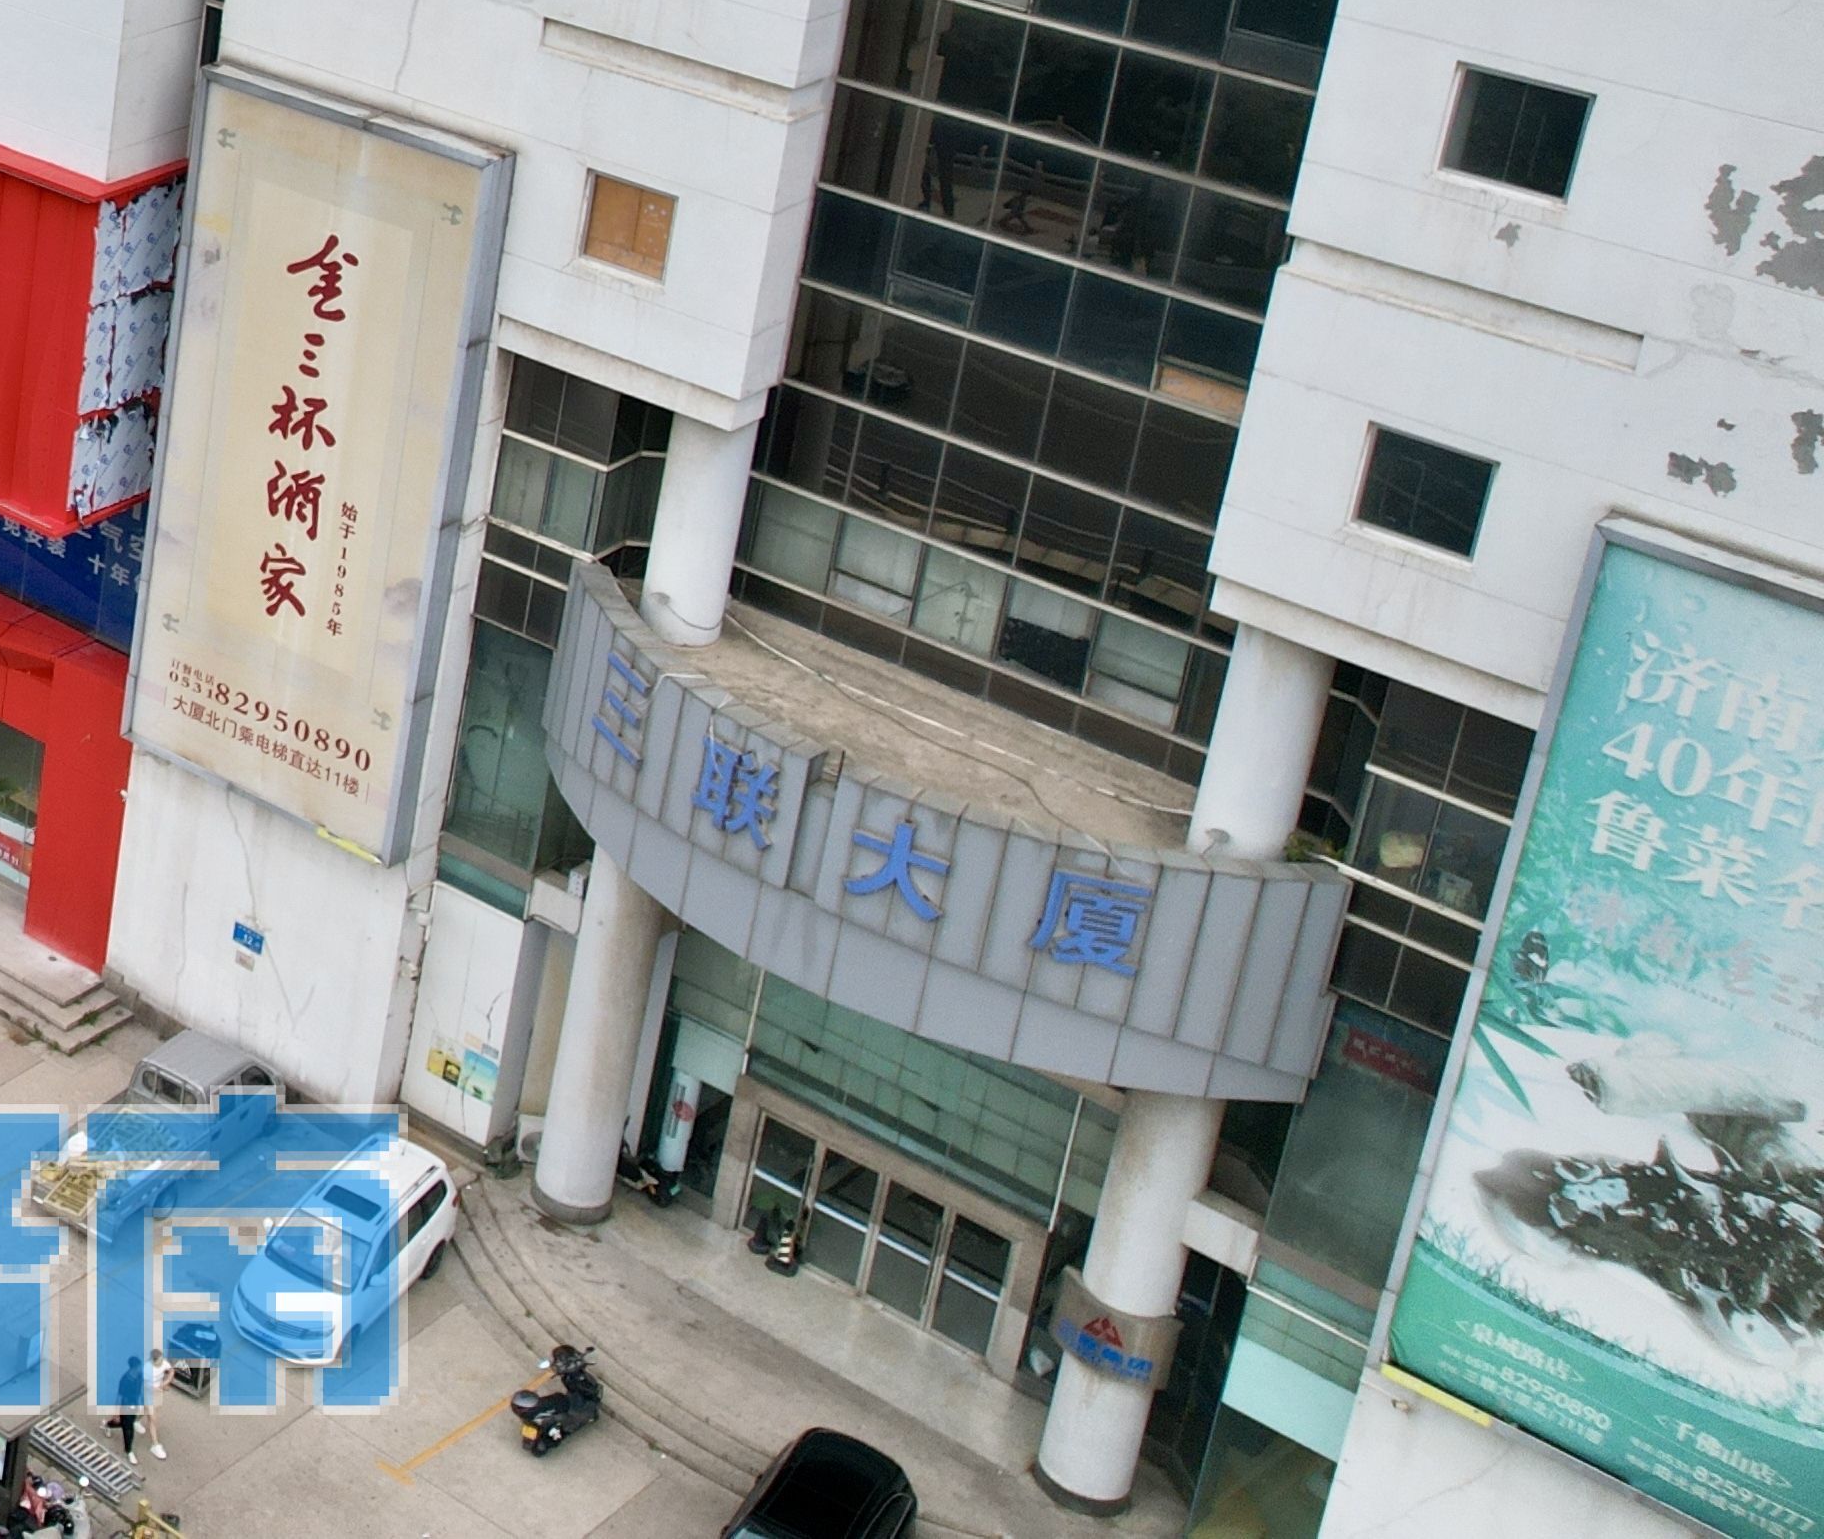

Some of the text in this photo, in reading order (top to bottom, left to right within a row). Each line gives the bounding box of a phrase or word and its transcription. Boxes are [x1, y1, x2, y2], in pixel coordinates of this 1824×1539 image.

[260, 234, 359, 618] 金三杯酒家
[326, 501, 358, 636] 始于1985年
[169, 671, 371, 771] 0531 82950890
[173, 695, 360, 797] 大厦北门乘电梯直达11楼
[1617, 631, 1824, 761] 济南
[591, 649, 1152, 978] 三联大厦
